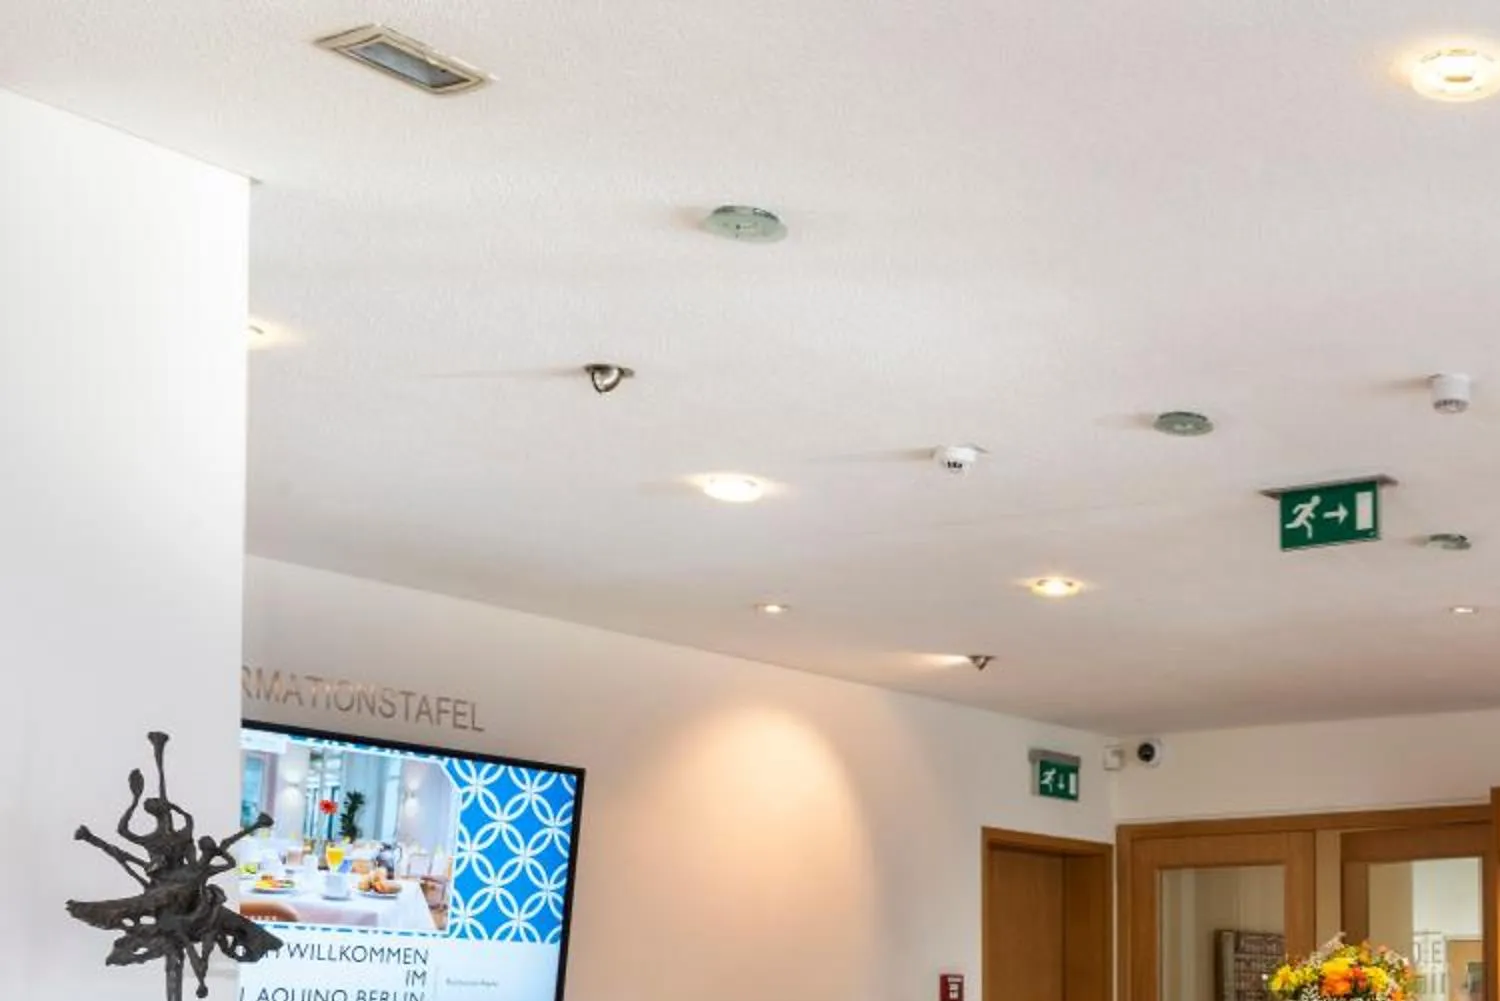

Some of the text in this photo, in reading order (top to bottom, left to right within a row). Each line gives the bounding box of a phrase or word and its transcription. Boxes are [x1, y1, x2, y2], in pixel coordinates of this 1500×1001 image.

[242, 666, 484, 732] RMATIONSTAFEL
[286, 942, 429, 965] WILLKOMMEN
[405, 969, 427, 987] IM
